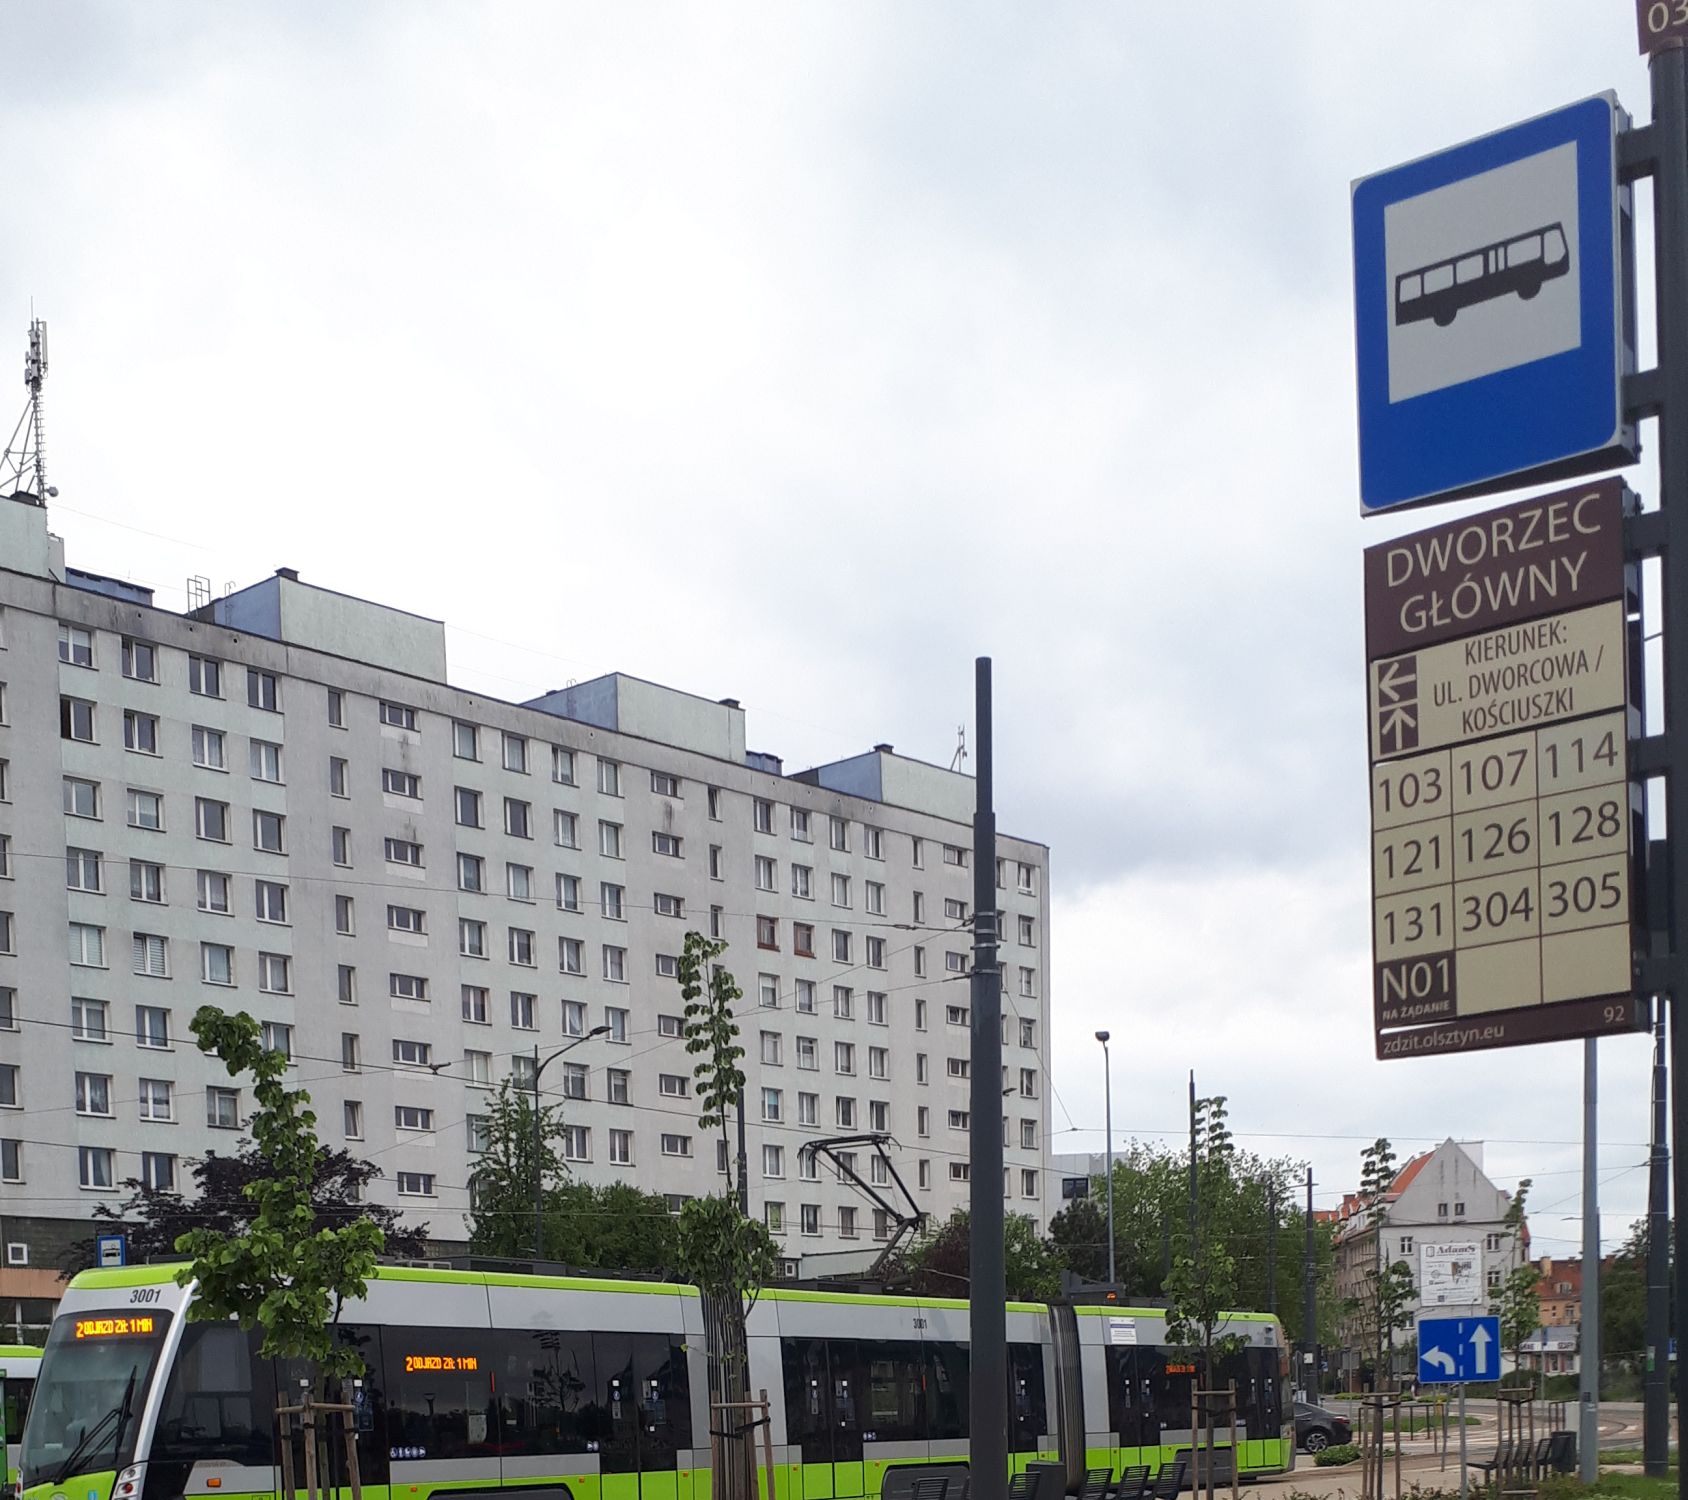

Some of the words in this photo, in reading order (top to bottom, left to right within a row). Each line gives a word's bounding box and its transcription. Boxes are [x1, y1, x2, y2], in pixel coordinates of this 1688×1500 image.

[1387, 493, 1601, 588] DWORZEC
[1400, 551, 1587, 633] GŁÓWNY
[1465, 620, 1567, 666] KIERUNEK:
[1433, 681, 1462, 707] UL.
[1469, 649, 1589, 699] DWORCOWA
[1595, 645, 1604, 672] /
[1462, 687, 1574, 734] KOŚCIUSZKI
[1460, 749, 1528, 795] 107
[1545, 731, 1618, 778] 114
[1379, 767, 1442, 812] 103
[1461, 817, 1531, 862] 126
[1548, 801, 1620, 846] 128
[1383, 835, 1440, 879] 121
[1462, 887, 1534, 932] 304
[1548, 871, 1621, 917] 305
[1384, 902, 1441, 945] 131
[1382, 958, 1449, 1003] N01
[1383, 1009, 1398, 1021] NA
[1400, 1001, 1450, 1019] ŻĄDANIE
[1603, 1005, 1625, 1023] 92
[1384, 1024, 1505, 1054] zdzit.olsztyn.eu
[130, 1288, 161, 1303] 3001
[76, 1321, 84, 1338] 2
[405, 1356, 413, 1371] 2
